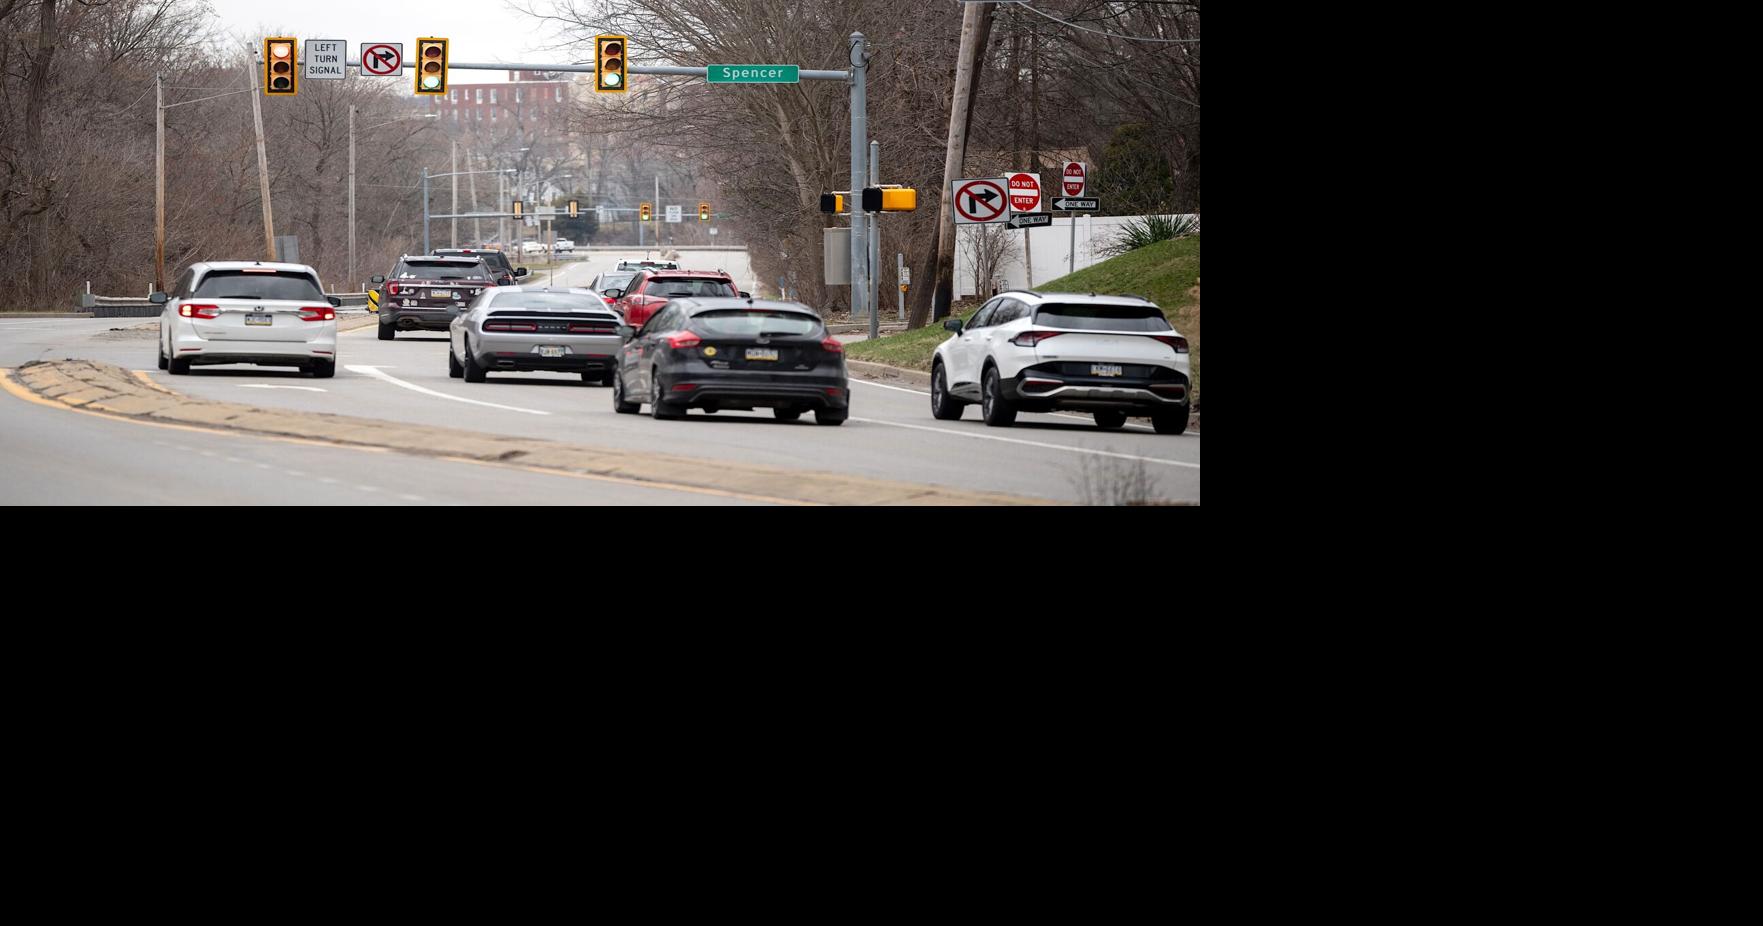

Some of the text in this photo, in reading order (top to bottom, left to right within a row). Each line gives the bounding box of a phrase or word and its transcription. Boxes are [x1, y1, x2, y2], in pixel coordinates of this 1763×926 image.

[314, 43, 336, 52] LEFT
[314, 54, 338, 62] TURN
[310, 66, 342, 74] SIGNAL
[722, 67, 784, 80] Spencer
